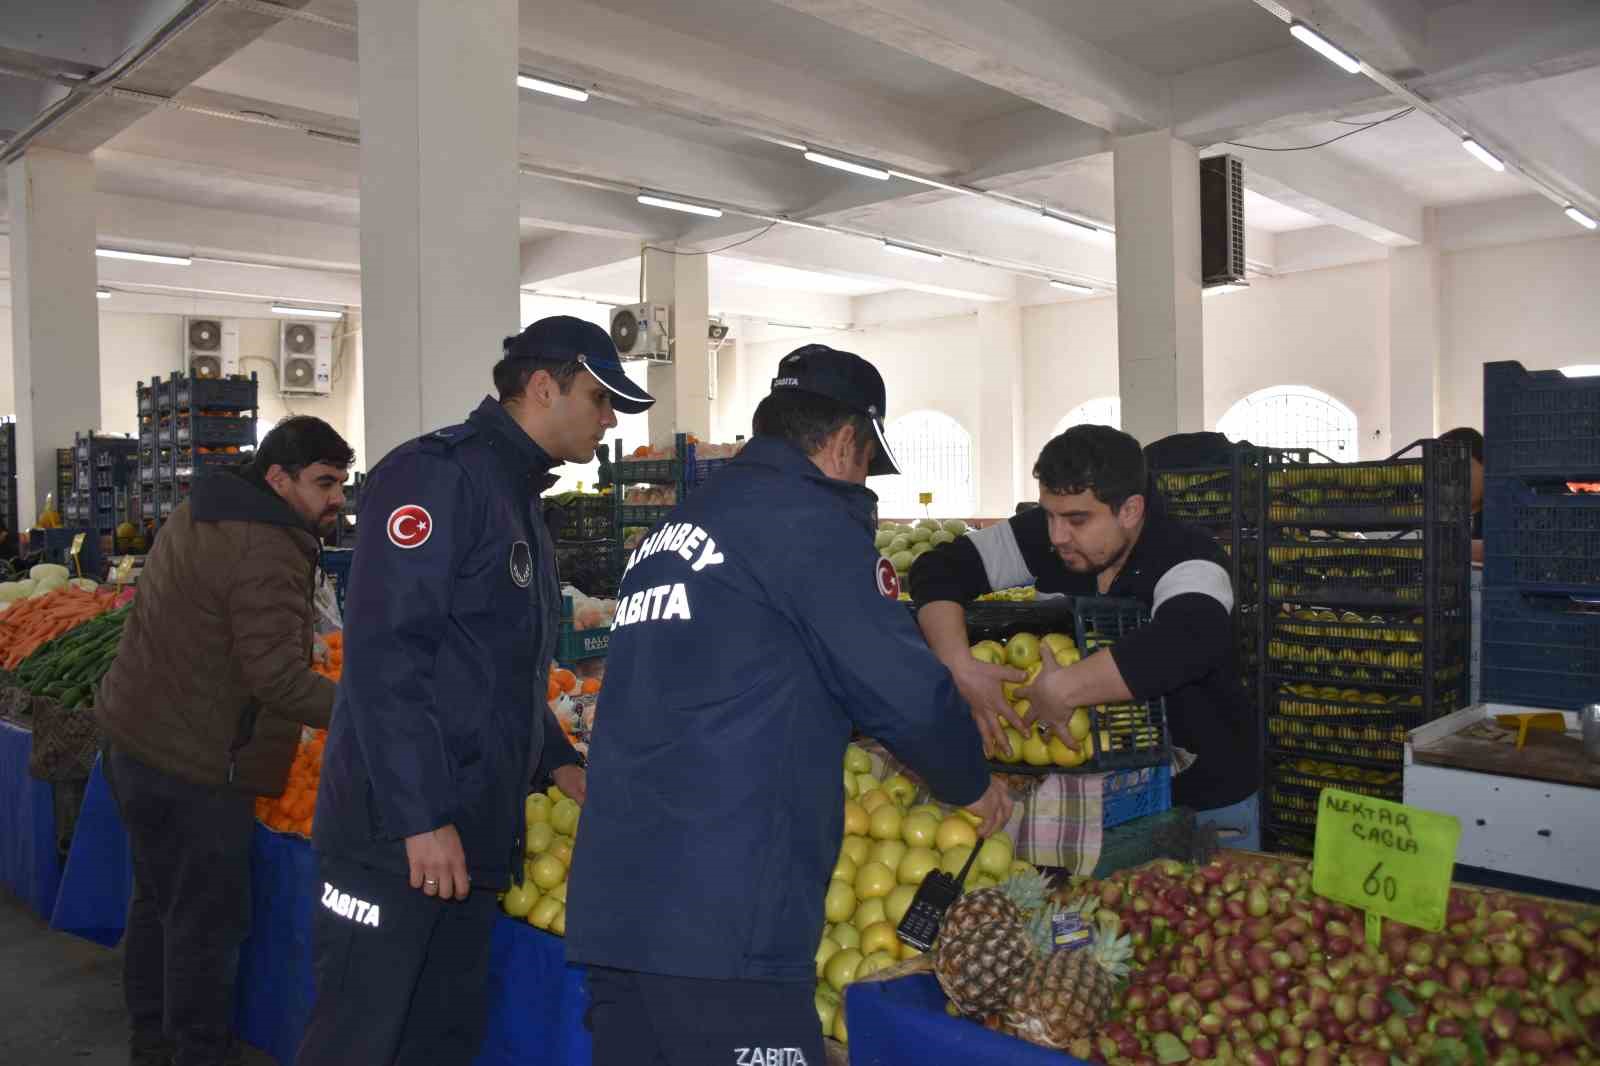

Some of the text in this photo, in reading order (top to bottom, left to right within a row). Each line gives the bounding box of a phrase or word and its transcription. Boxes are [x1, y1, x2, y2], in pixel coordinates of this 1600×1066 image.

[617, 522, 724, 597] AHİNBEY
[1363, 861, 1396, 902] 60
[734, 1048, 808, 1066] ZABITA
